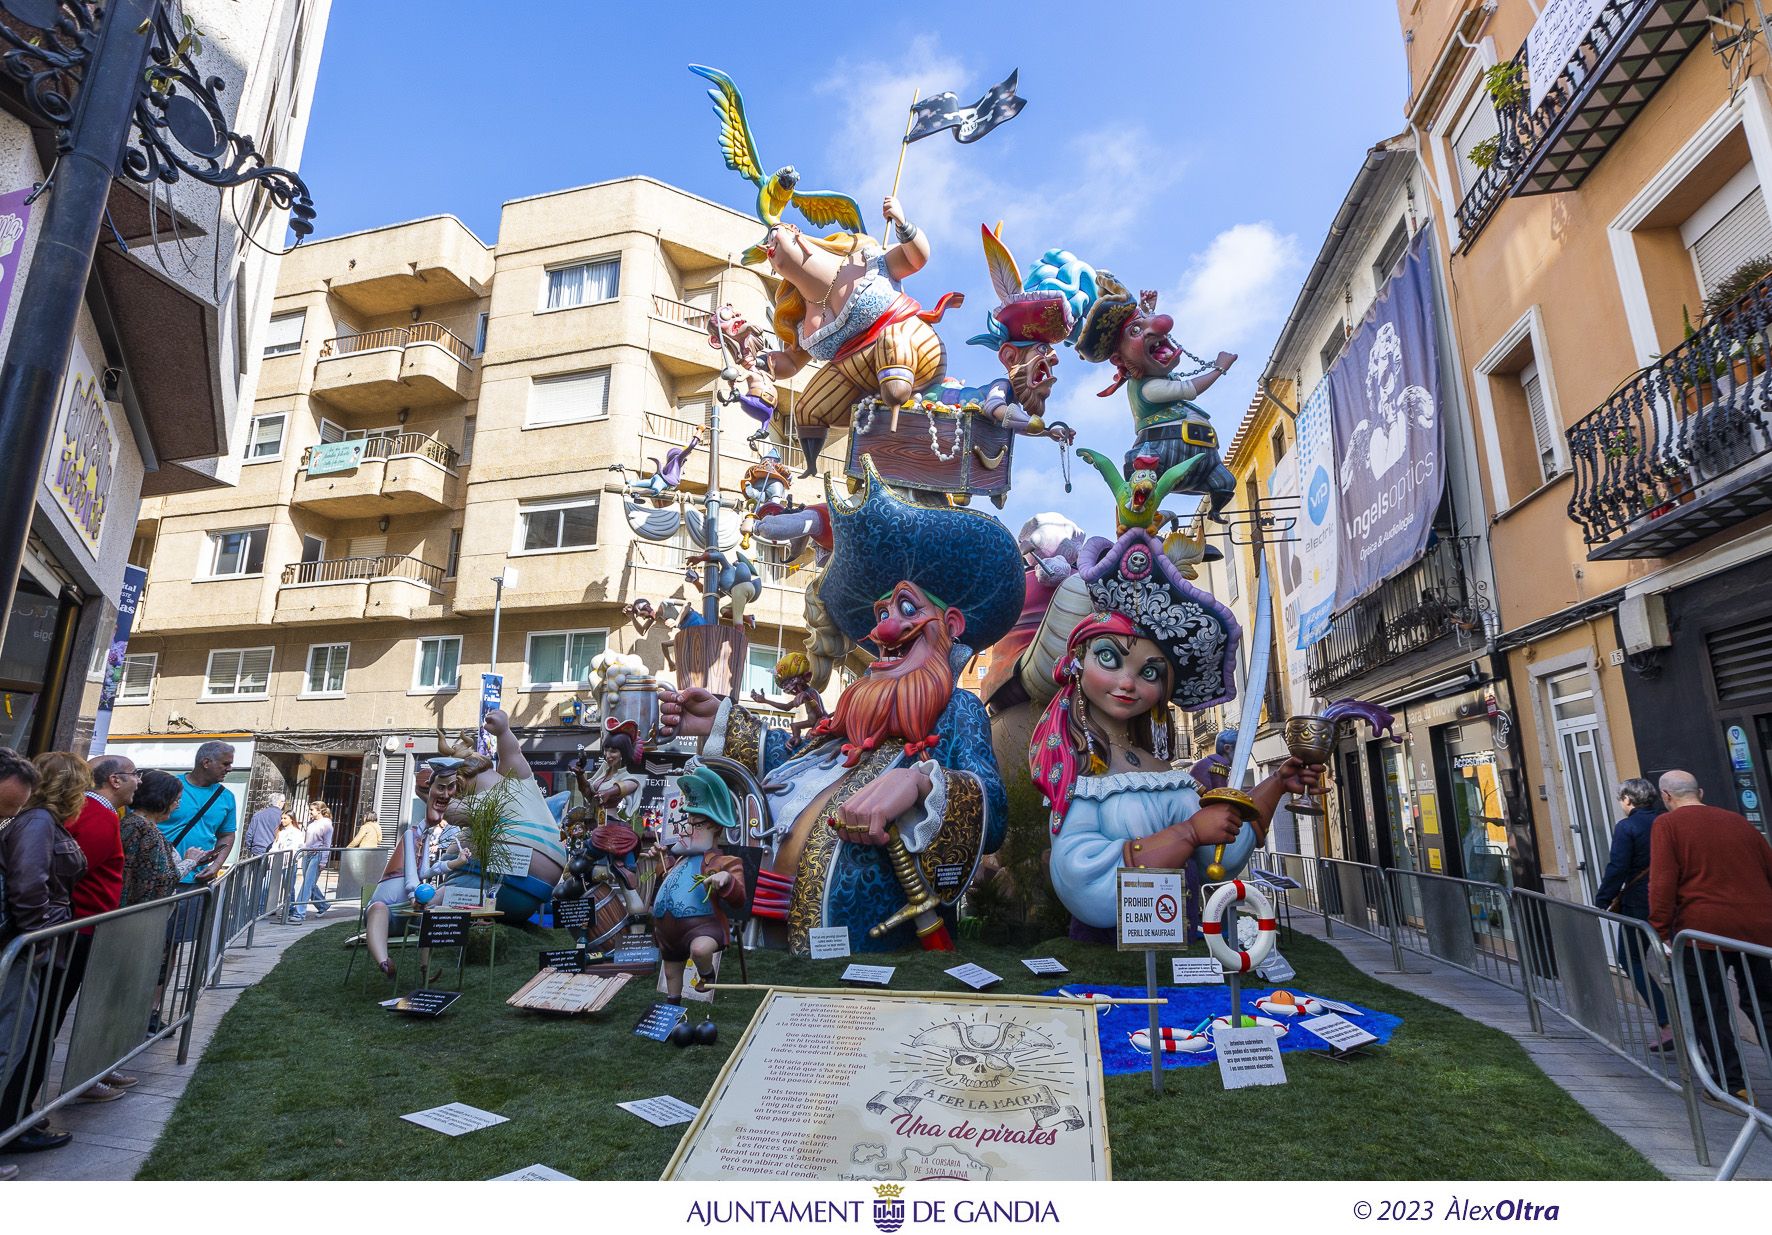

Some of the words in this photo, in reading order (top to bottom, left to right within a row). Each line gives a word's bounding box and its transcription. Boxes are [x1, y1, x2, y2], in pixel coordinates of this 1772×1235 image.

[646, 779, 671, 787] TEXTIL
[1124, 897, 1153, 907] PROHIBIT
[1126, 913, 1133, 922] EL
[1135, 913, 1152, 922] BANY
[923, 1089, 935, 1099] A
[938, 1095, 964, 1108] FER
[968, 1099, 988, 1109] LA
[890, 1113, 945, 1139] Una
[948, 1120, 978, 1140] de
[975, 1123, 1058, 1148] pirates
[720, 1148, 748, 1156] durant
[790, 1155, 838, 1164] s'abstenen.
[737, 1166, 773, 1175] comptes
[790, 1171, 819, 1179] rendir.
[785, 1162, 827, 1171] eleccions
[913, 1165, 922, 1174] DE
[925, 1168, 946, 1176] SANTA
[948, 1170, 968, 1178] ANNA
